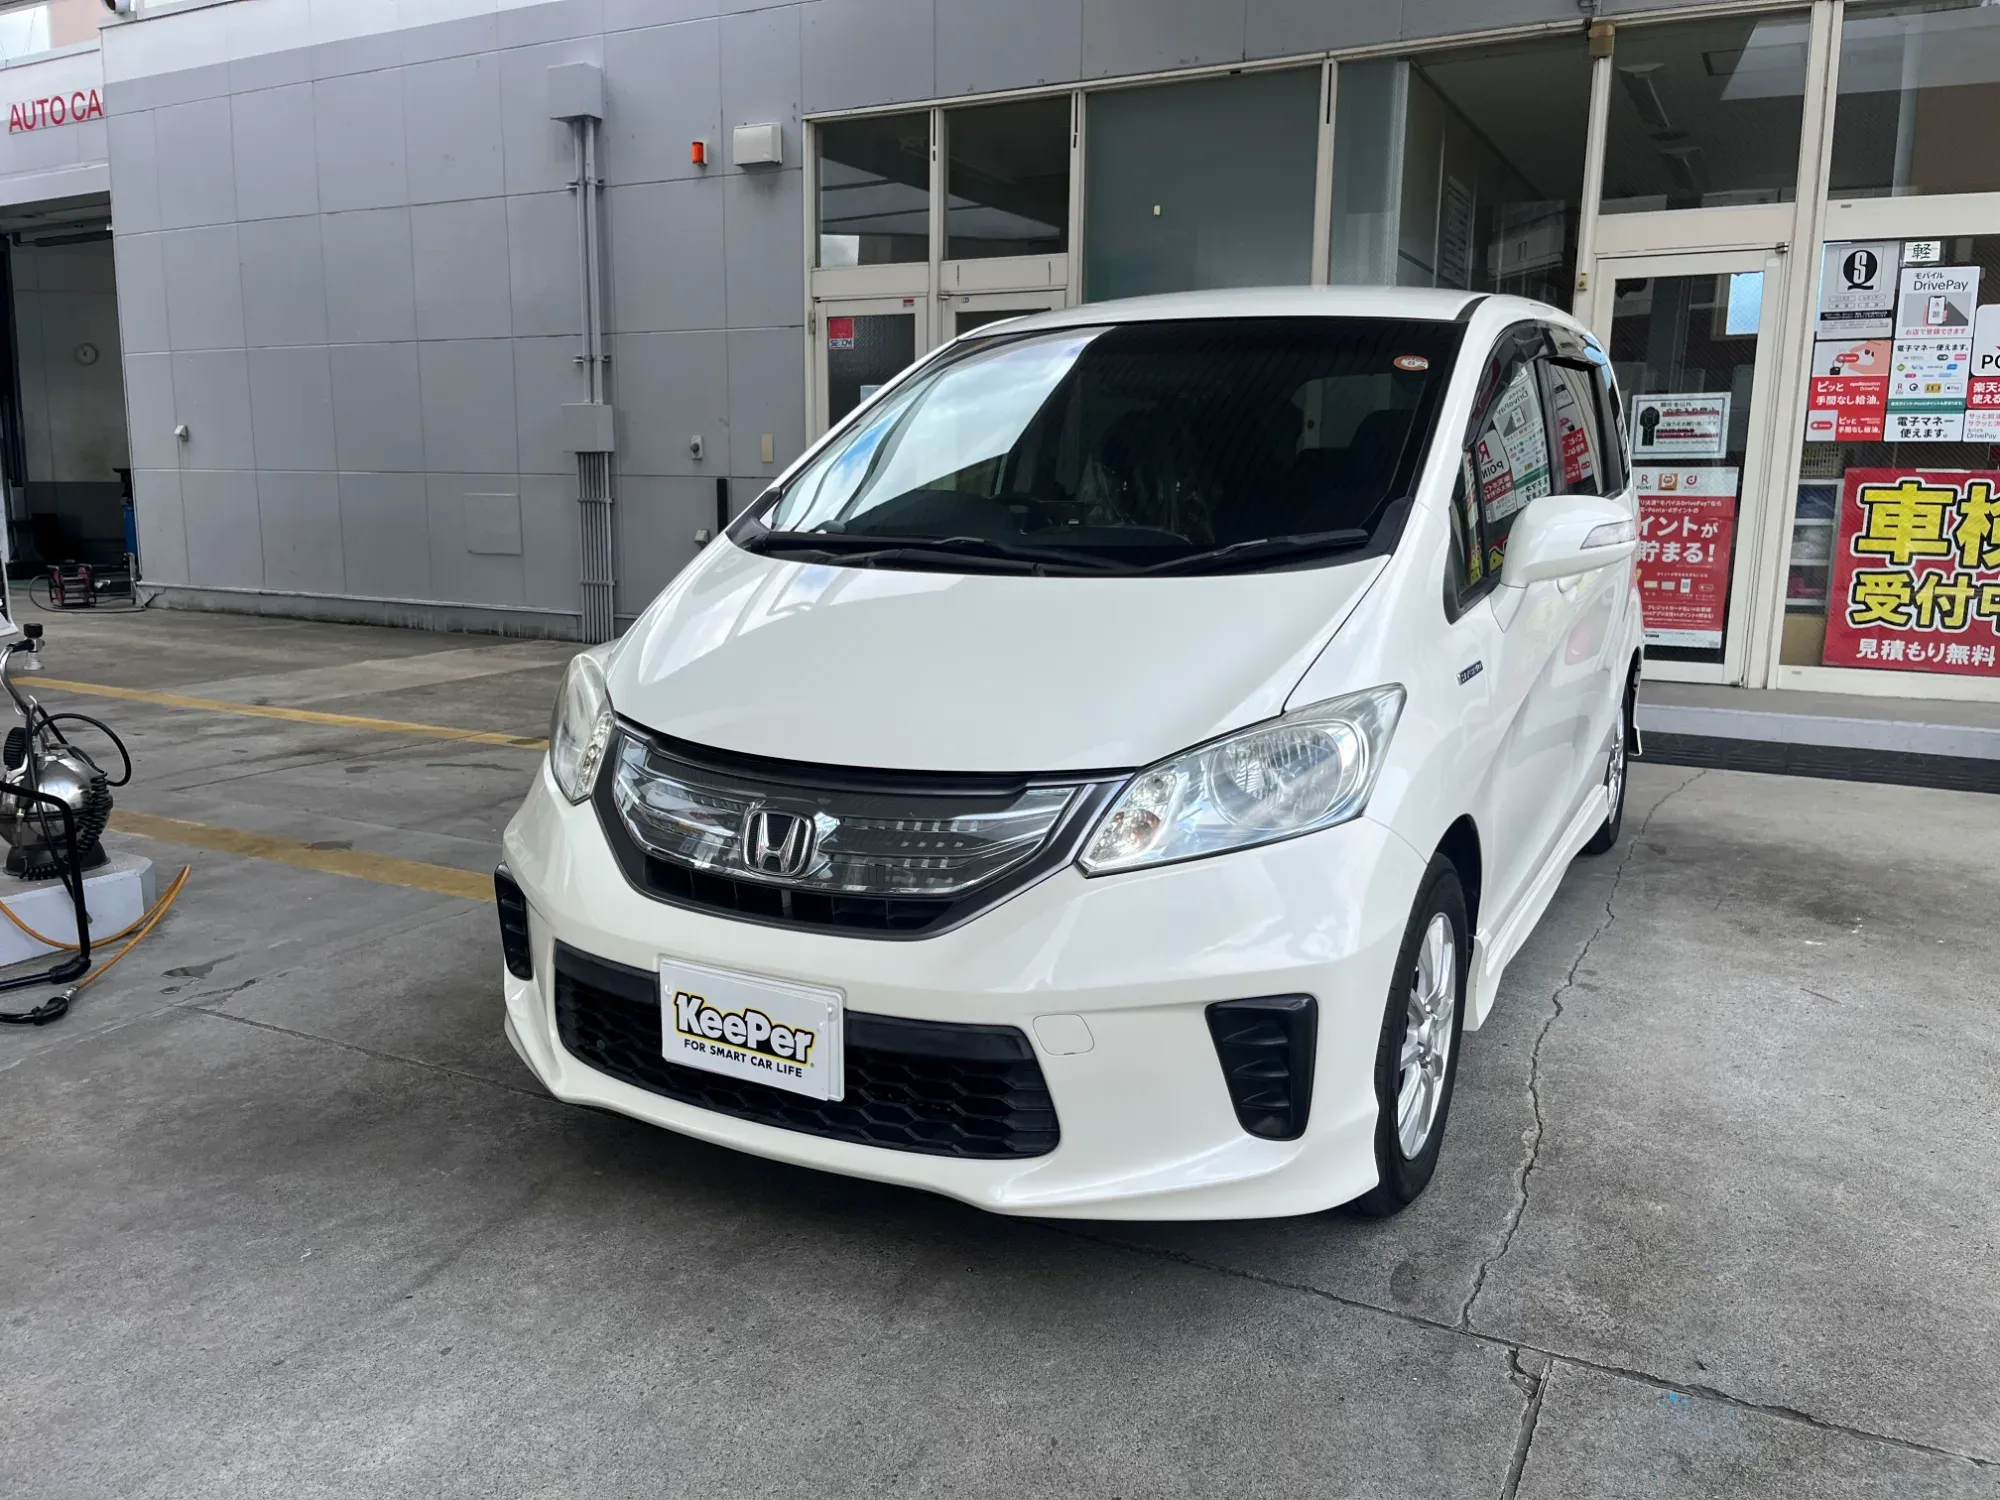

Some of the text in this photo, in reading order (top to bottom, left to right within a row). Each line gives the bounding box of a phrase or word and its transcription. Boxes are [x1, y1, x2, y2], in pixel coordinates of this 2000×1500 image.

[8, 89, 103, 133] AUTO CA
[1911, 243, 1932, 260] 軽
[1913, 280, 1968, 292] DrivePay
[1897, 343, 1969, 352] 電子マネー使えます。
[1817, 381, 1844, 392] ピッと
[1973, 382, 2000, 393] 楽天
[1816, 394, 1880, 406] 手間なし給油。
[1897, 416, 1955, 426] 電子マネー
[1900, 428, 1948, 438] 使えます。
[1856, 638, 1996, 667] 見積もり無料
[674, 991, 815, 1065] KeePer
[684, 1038, 803, 1079] FOR SMART CAR LIFE
